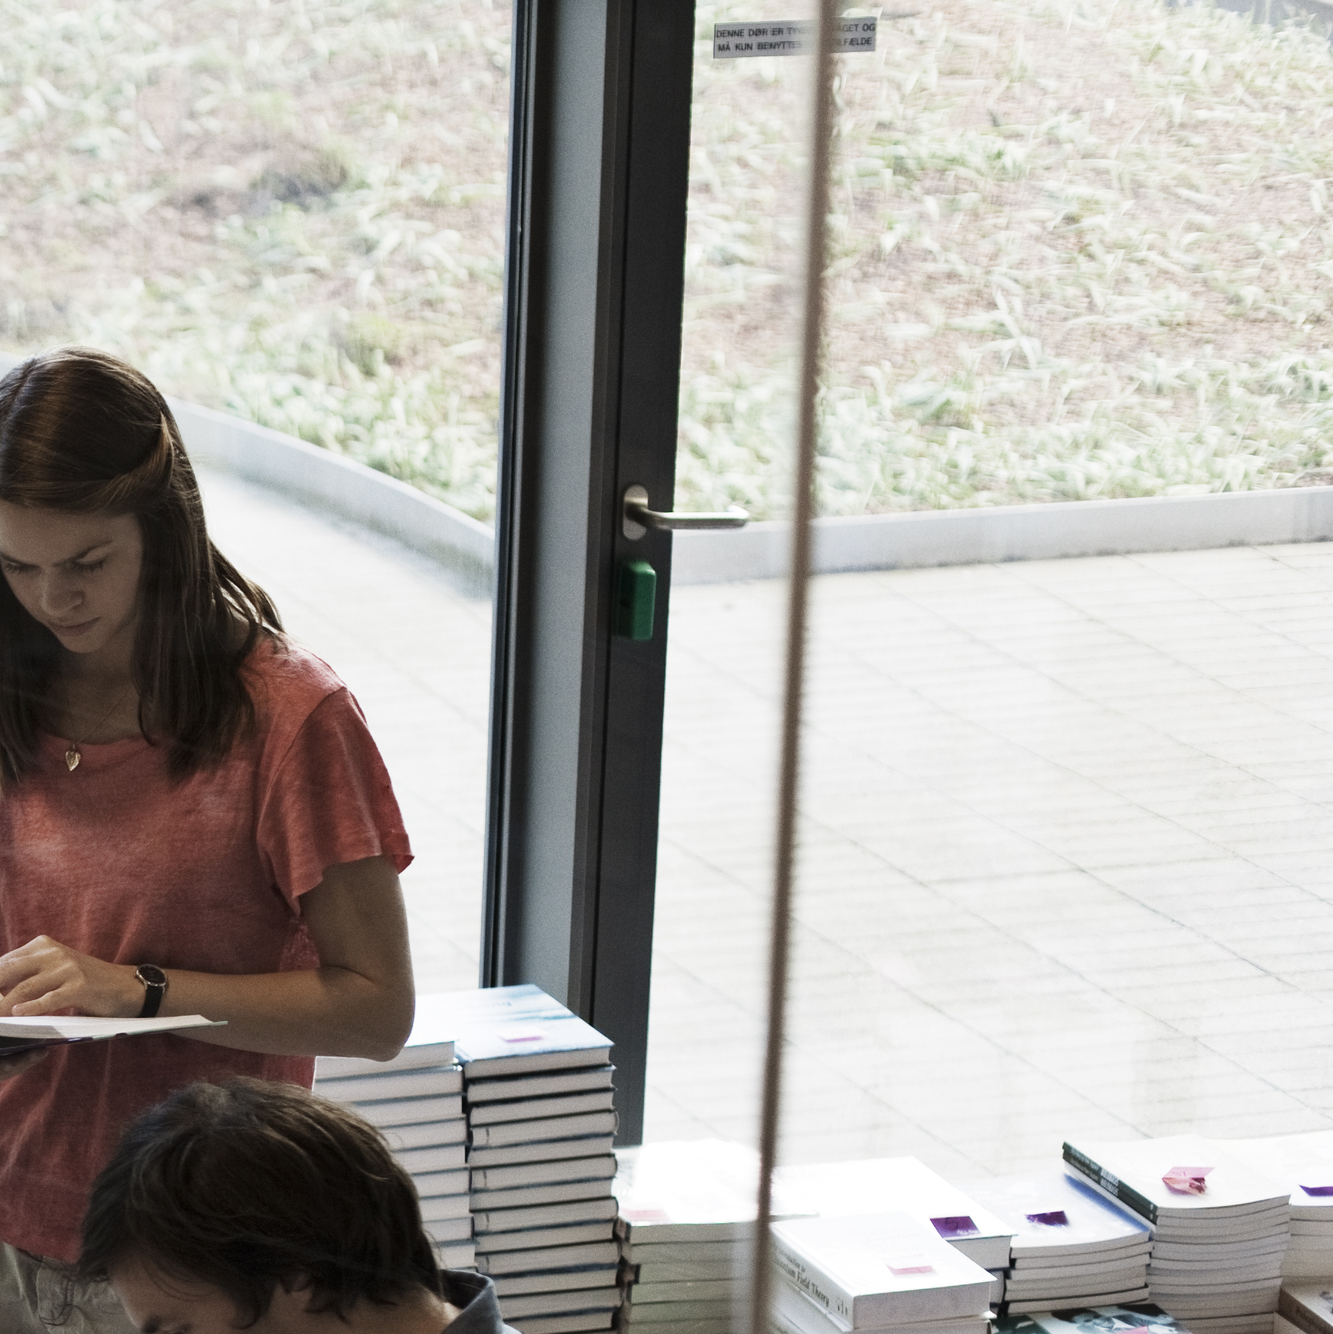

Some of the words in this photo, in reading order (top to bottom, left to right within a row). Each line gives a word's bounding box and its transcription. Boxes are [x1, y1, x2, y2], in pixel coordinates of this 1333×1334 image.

[716, 29, 745, 38] DENNE
[748, 28, 768, 37] DØR
[862, 23, 876, 32] OG
[718, 42, 731, 52] MÅ
[735, 42, 753, 51] KUN
[797, 1272, 811, 1290] Field
[812, 1282, 830, 1307] Theory
